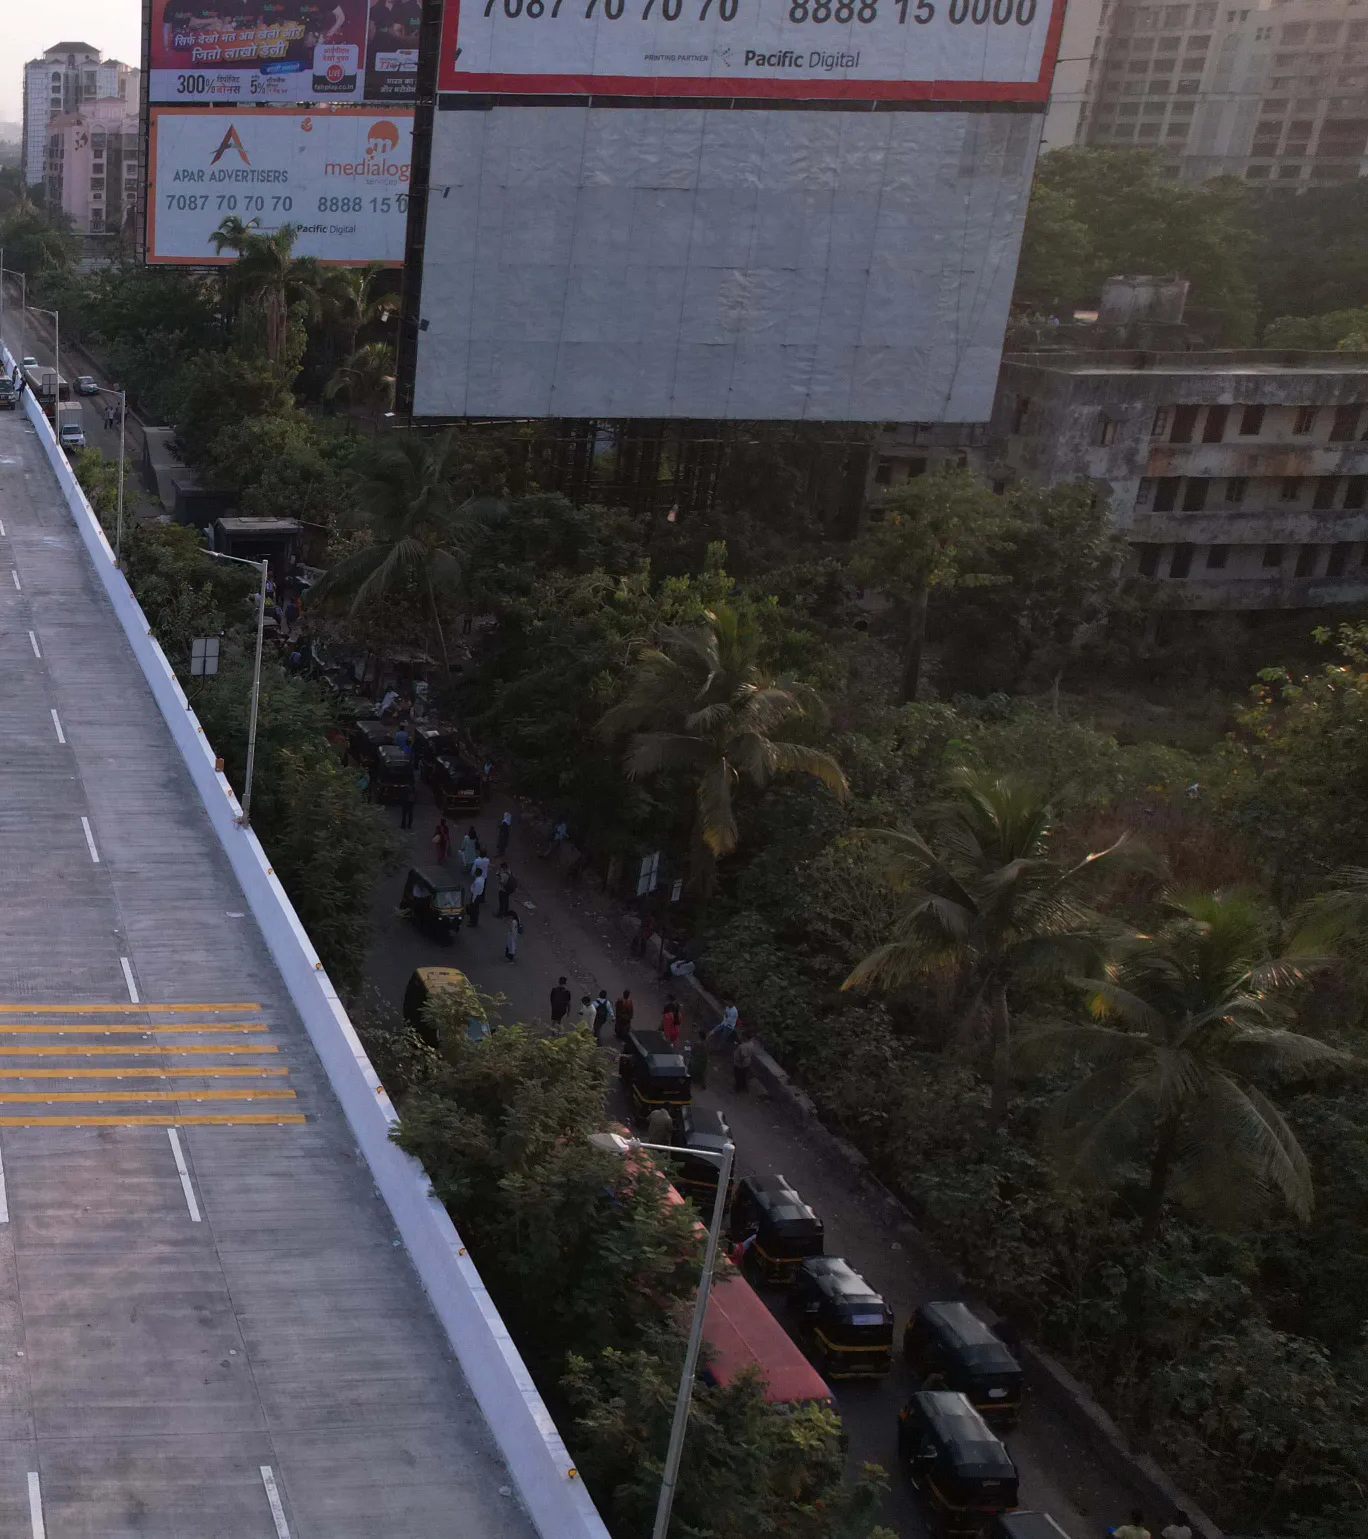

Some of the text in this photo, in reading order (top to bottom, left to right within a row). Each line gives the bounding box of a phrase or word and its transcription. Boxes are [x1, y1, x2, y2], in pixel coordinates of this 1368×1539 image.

[585, 0, 625, 20] 70
[642, 0, 683, 21] 70
[699, 0, 739, 22] 70
[789, 0, 878, 24] 8888
[893, 0, 935, 25] 15
[948, 0, 1037, 26] 0000
[744, 50, 860, 72] Pacific Digital
[173, 169, 288, 183] APAR ADVERTISERS
[166, 194, 209, 211] 7087
[216, 195, 237, 211] 70
[244, 195, 264, 211] 70
[271, 195, 293, 212] 70
[318, 196, 362, 213] 8888
[370, 196, 391, 213] 15
[297, 224, 356, 235] Pacific Digital
